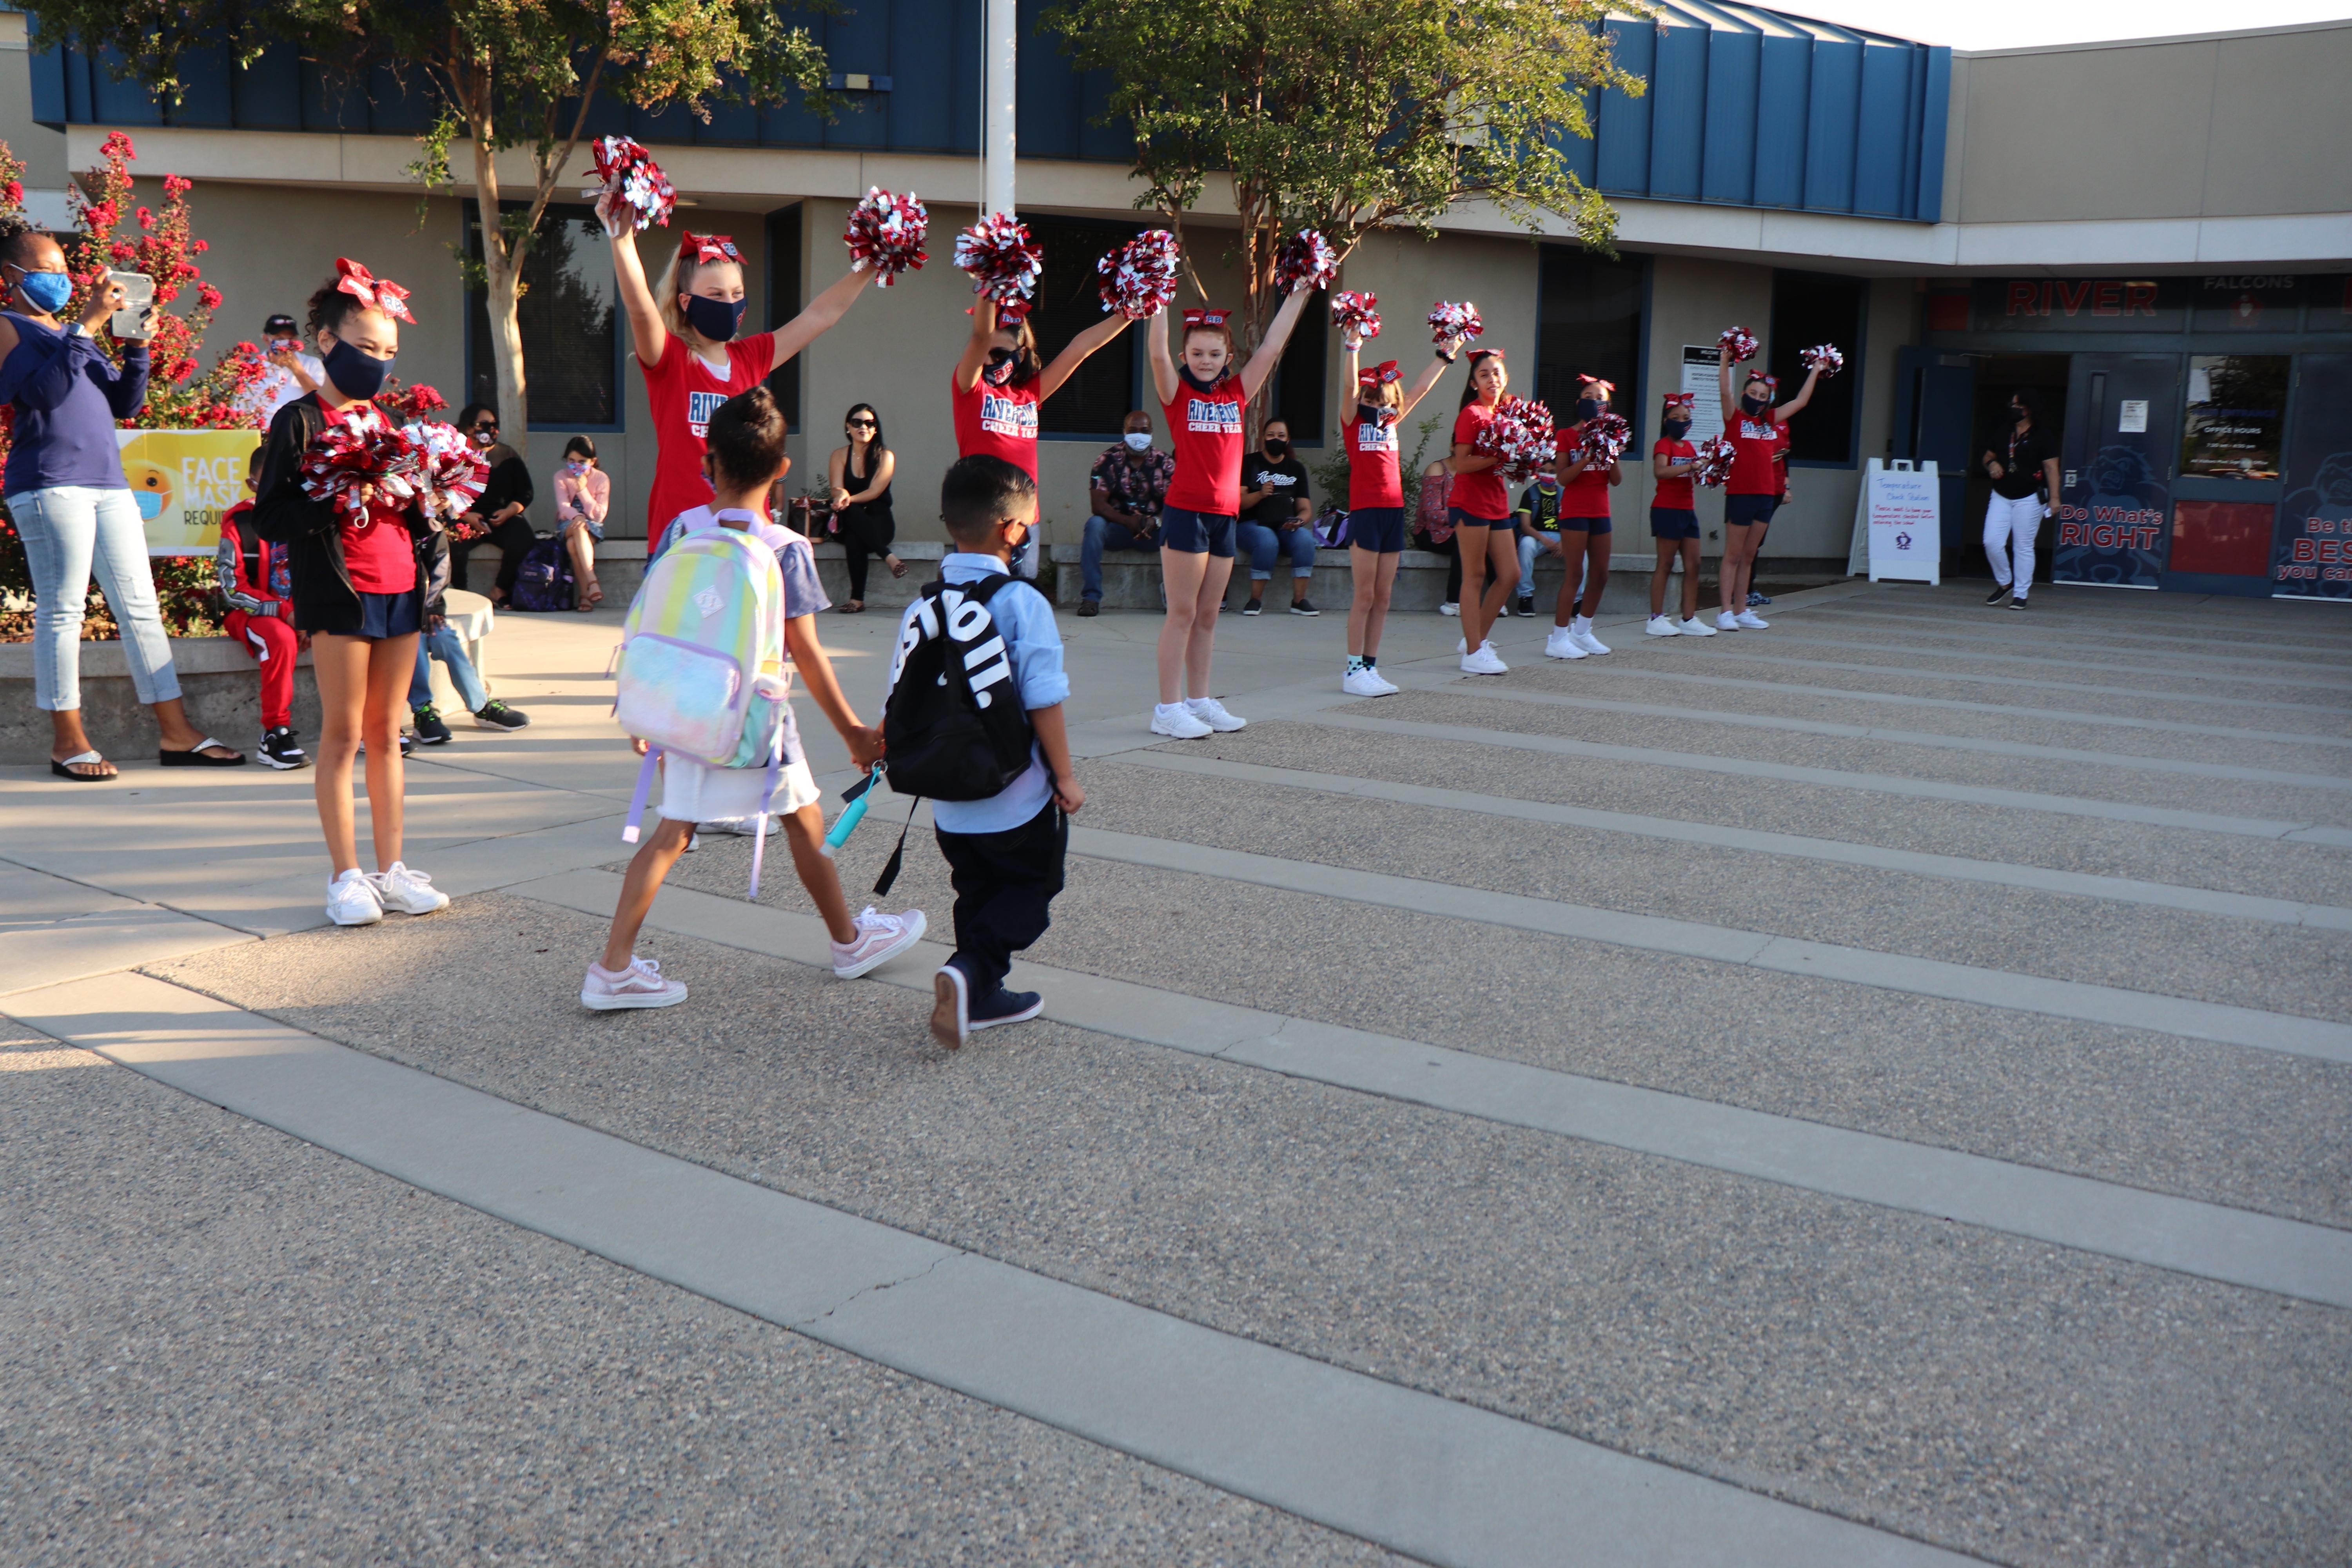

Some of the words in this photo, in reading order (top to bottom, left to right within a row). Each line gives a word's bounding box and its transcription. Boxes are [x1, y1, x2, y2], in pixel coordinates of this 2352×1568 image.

[2203, 275, 2295, 290] FALCONS
[2006, 281, 2158, 316] RIVER
[982, 420, 1019, 437] CHEER
[1188, 422, 1221, 433] CHEER
[181, 457, 241, 485] FACE
[184, 485, 242, 509] MASK
[184, 511, 228, 525] REQUI
[2060, 504, 2089, 521] Do
[2093, 506, 2164, 525] What's
[2306, 517, 2336, 534] Be
[2060, 523, 2160, 550] RIGHT
[2277, 565, 2318, 581] you
